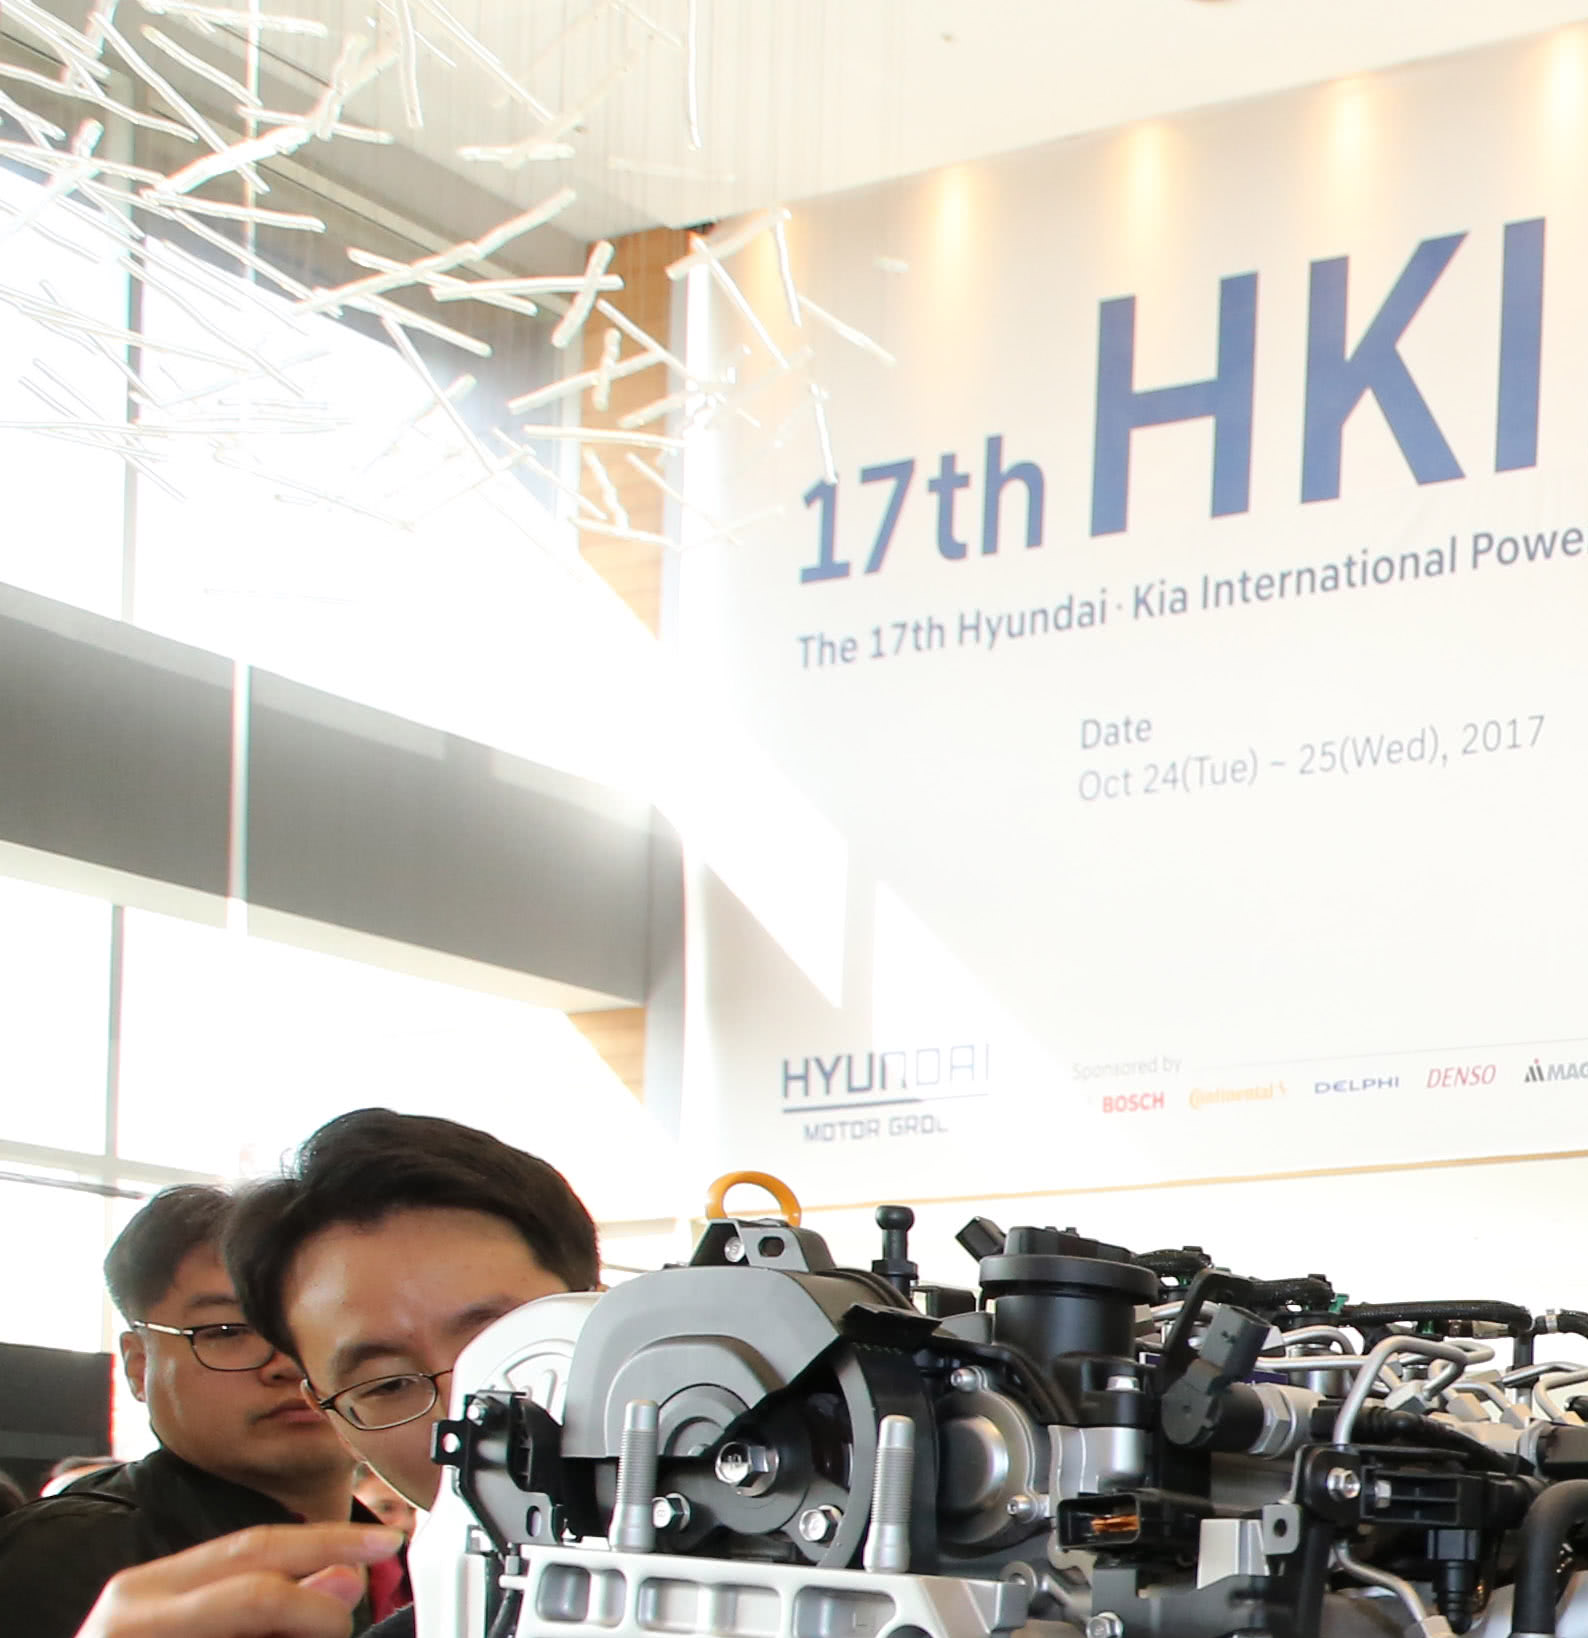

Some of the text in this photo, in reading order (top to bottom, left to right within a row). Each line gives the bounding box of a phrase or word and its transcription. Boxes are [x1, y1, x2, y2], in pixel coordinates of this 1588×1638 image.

[798, 434, 1046, 585] 17th
[796, 631, 859, 668] The
[869, 616, 946, 660] 17th
[1132, 579, 1189, 620] Kia
[1201, 535, 1458, 610] International
[1078, 767, 1134, 803] Oct
[1142, 748, 1259, 795] 24(Tue)
[1298, 724, 1449, 776] 25(Wed),
[1460, 714, 1545, 757] 2017
[1079, 714, 1153, 751] Date
[1102, 1091, 1164, 1114] BOSCH
[1313, 1076, 1400, 1095] DELPHI
[1426, 1064, 1496, 1089] DENSO
[803, 1114, 949, 1142] MOTOR GRO
